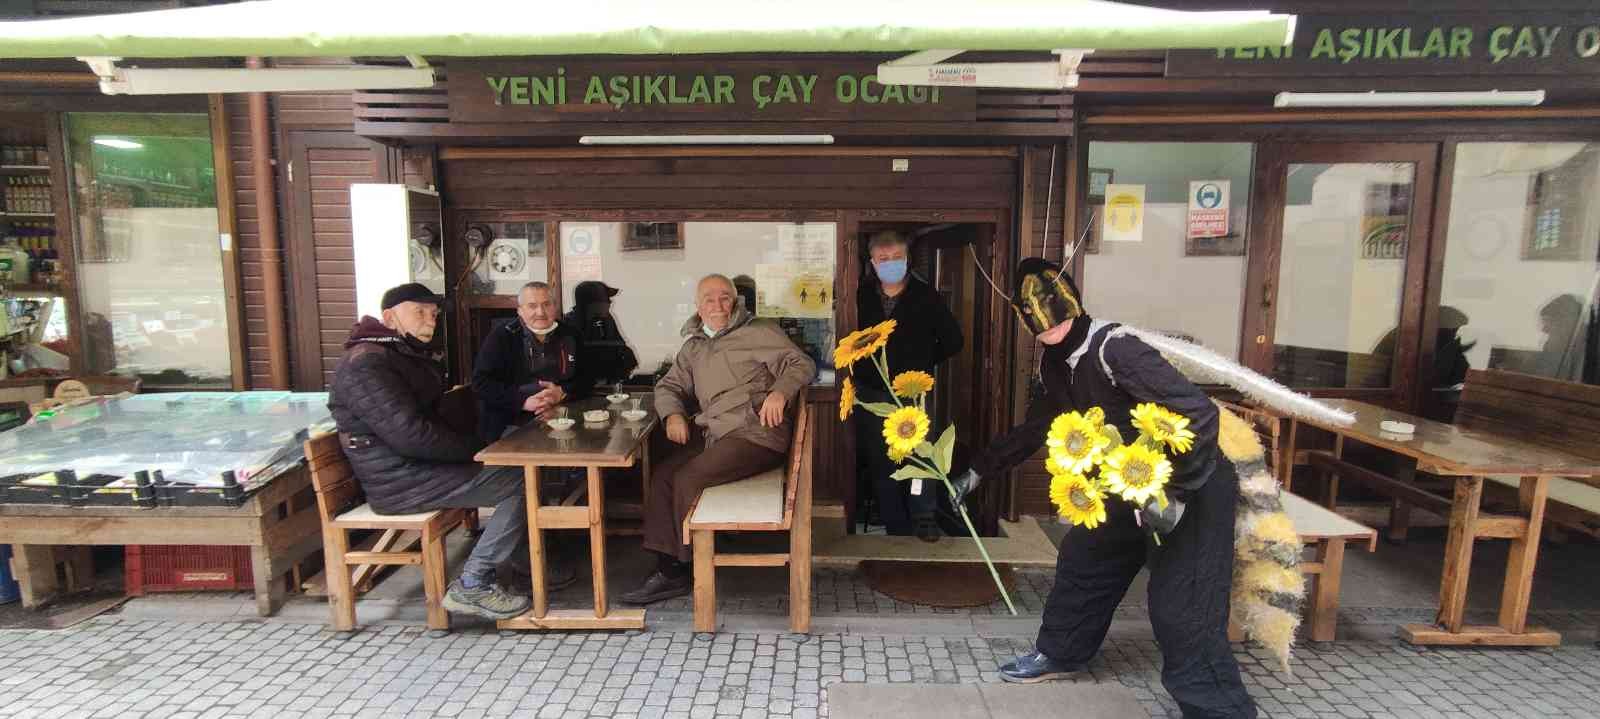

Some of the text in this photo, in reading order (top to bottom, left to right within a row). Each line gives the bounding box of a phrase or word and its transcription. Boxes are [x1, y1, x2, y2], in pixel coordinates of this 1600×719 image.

[1311, 28, 1474, 63] AŞIKLAR
[1488, 27, 1563, 64] ÇAY
[485, 67, 567, 105] YENİ
[583, 75, 736, 110] AŞIKLAR
[751, 75, 819, 109] ÇAY
